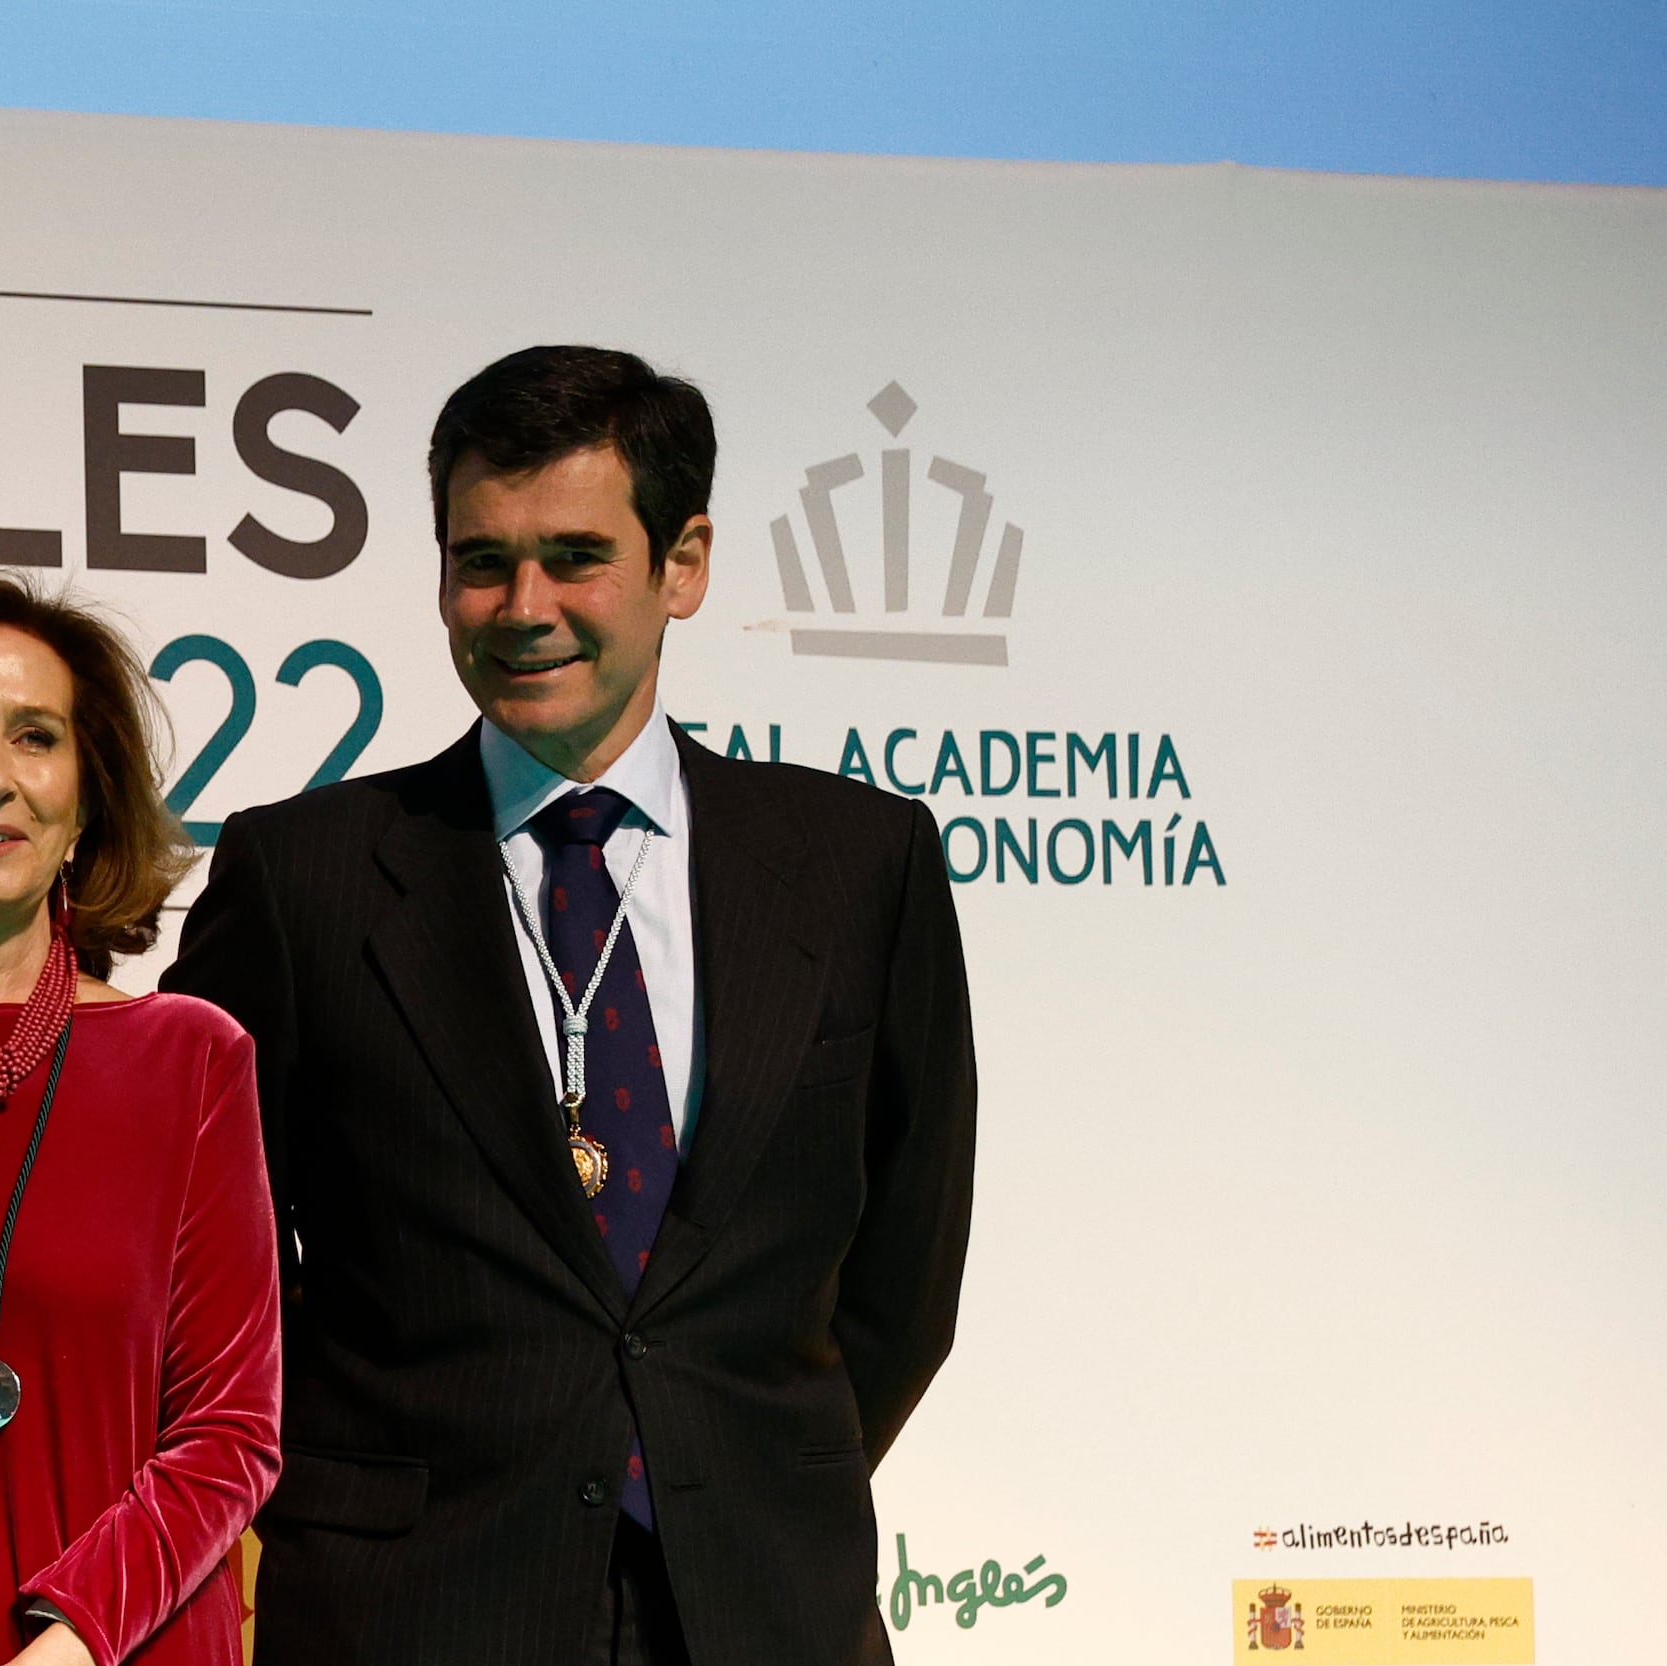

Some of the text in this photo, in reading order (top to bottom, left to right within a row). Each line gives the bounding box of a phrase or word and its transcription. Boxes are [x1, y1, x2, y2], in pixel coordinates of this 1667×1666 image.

[148, 634, 383, 848] 22
[838, 727, 1191, 800] ACADEMIA
[941, 812, 1227, 886] ONOMÍA
[1253, 1521, 1510, 1552] #alimentosdespaña
[890, 1532, 1067, 1631] Inglés
[1316, 1605, 1373, 1617] GOBIERNO
[1401, 1605, 1457, 1615] MINISTERIO
[1316, 1616, 1372, 1629] DE ESPAÑA
[1402, 1618, 1416, 1628] DE
[1489, 1616, 1520, 1627] PESCA
[1403, 1629, 1485, 1641] Y ALIMENTACIÓN
